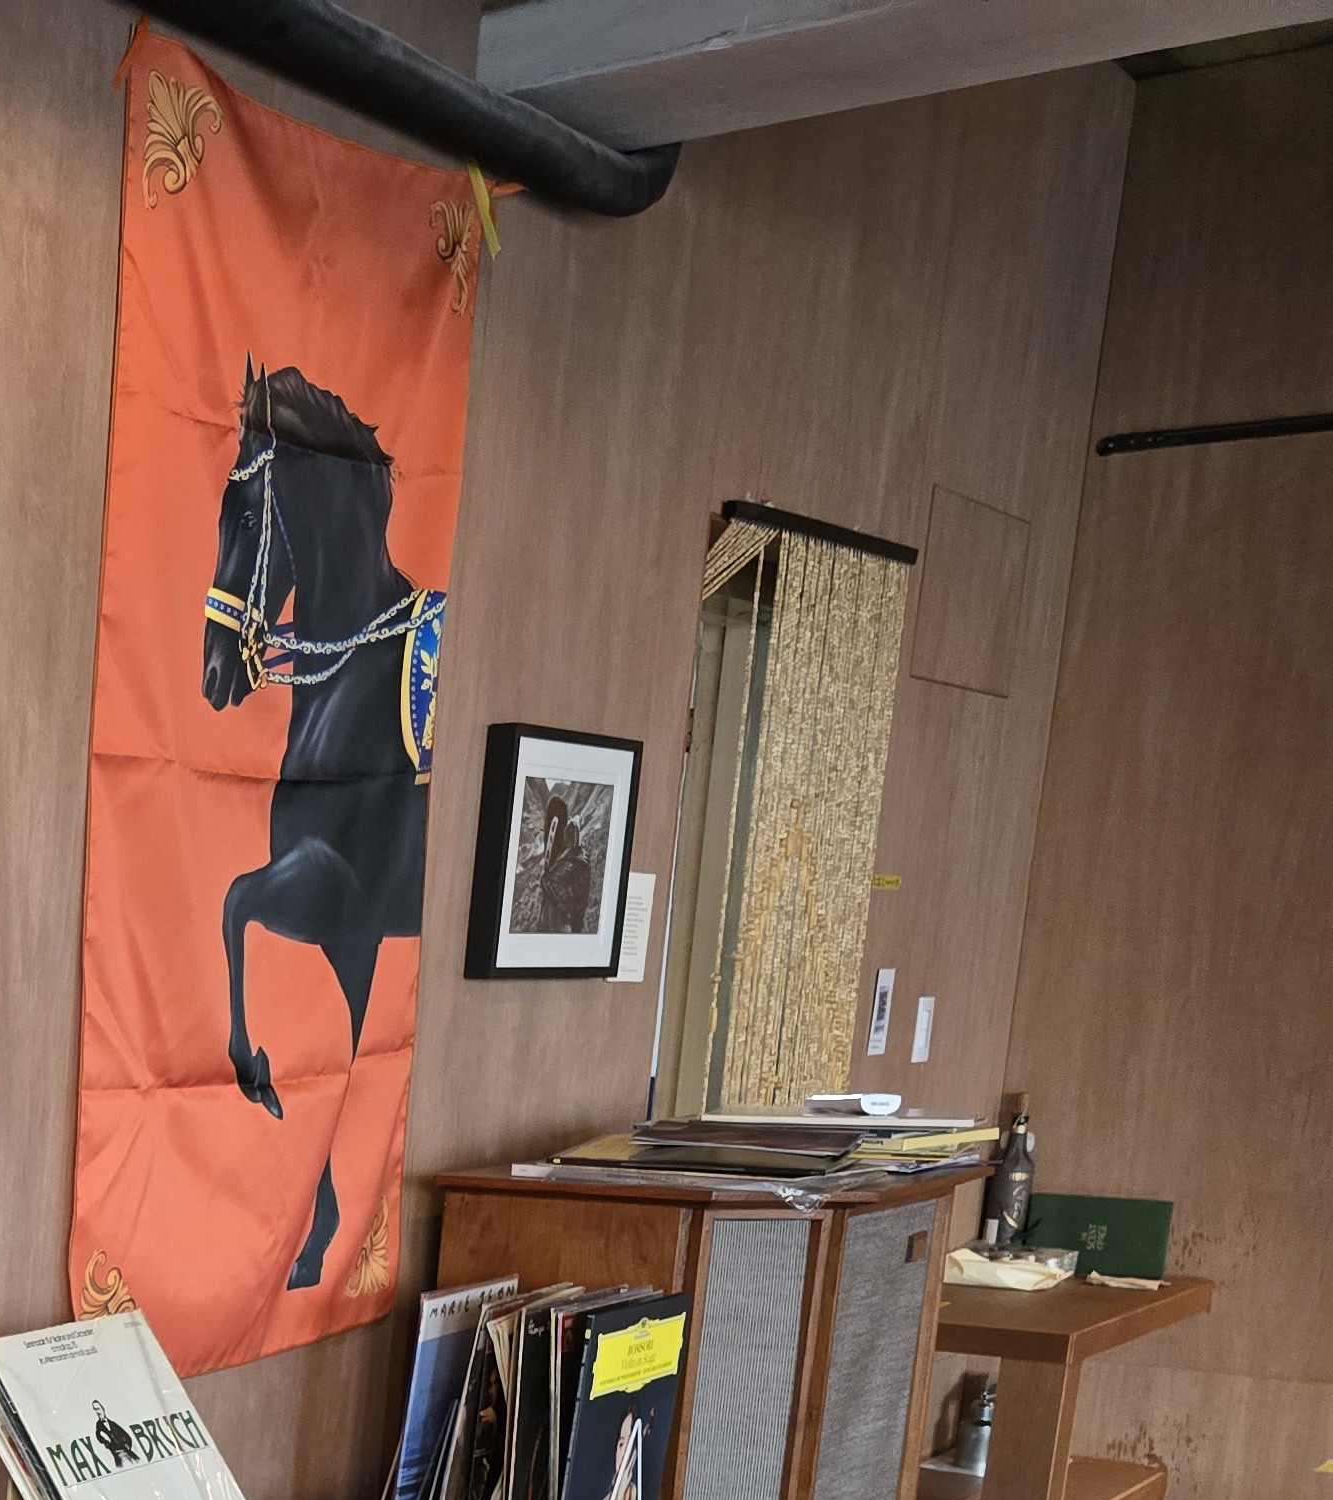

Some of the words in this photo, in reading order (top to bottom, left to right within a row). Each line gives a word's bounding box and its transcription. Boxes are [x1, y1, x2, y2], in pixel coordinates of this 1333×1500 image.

[429, 1301, 470, 1319] MARIE
[46, 1436, 111, 1486] MAX
[129, 1410, 208, 1462] BRUCH
